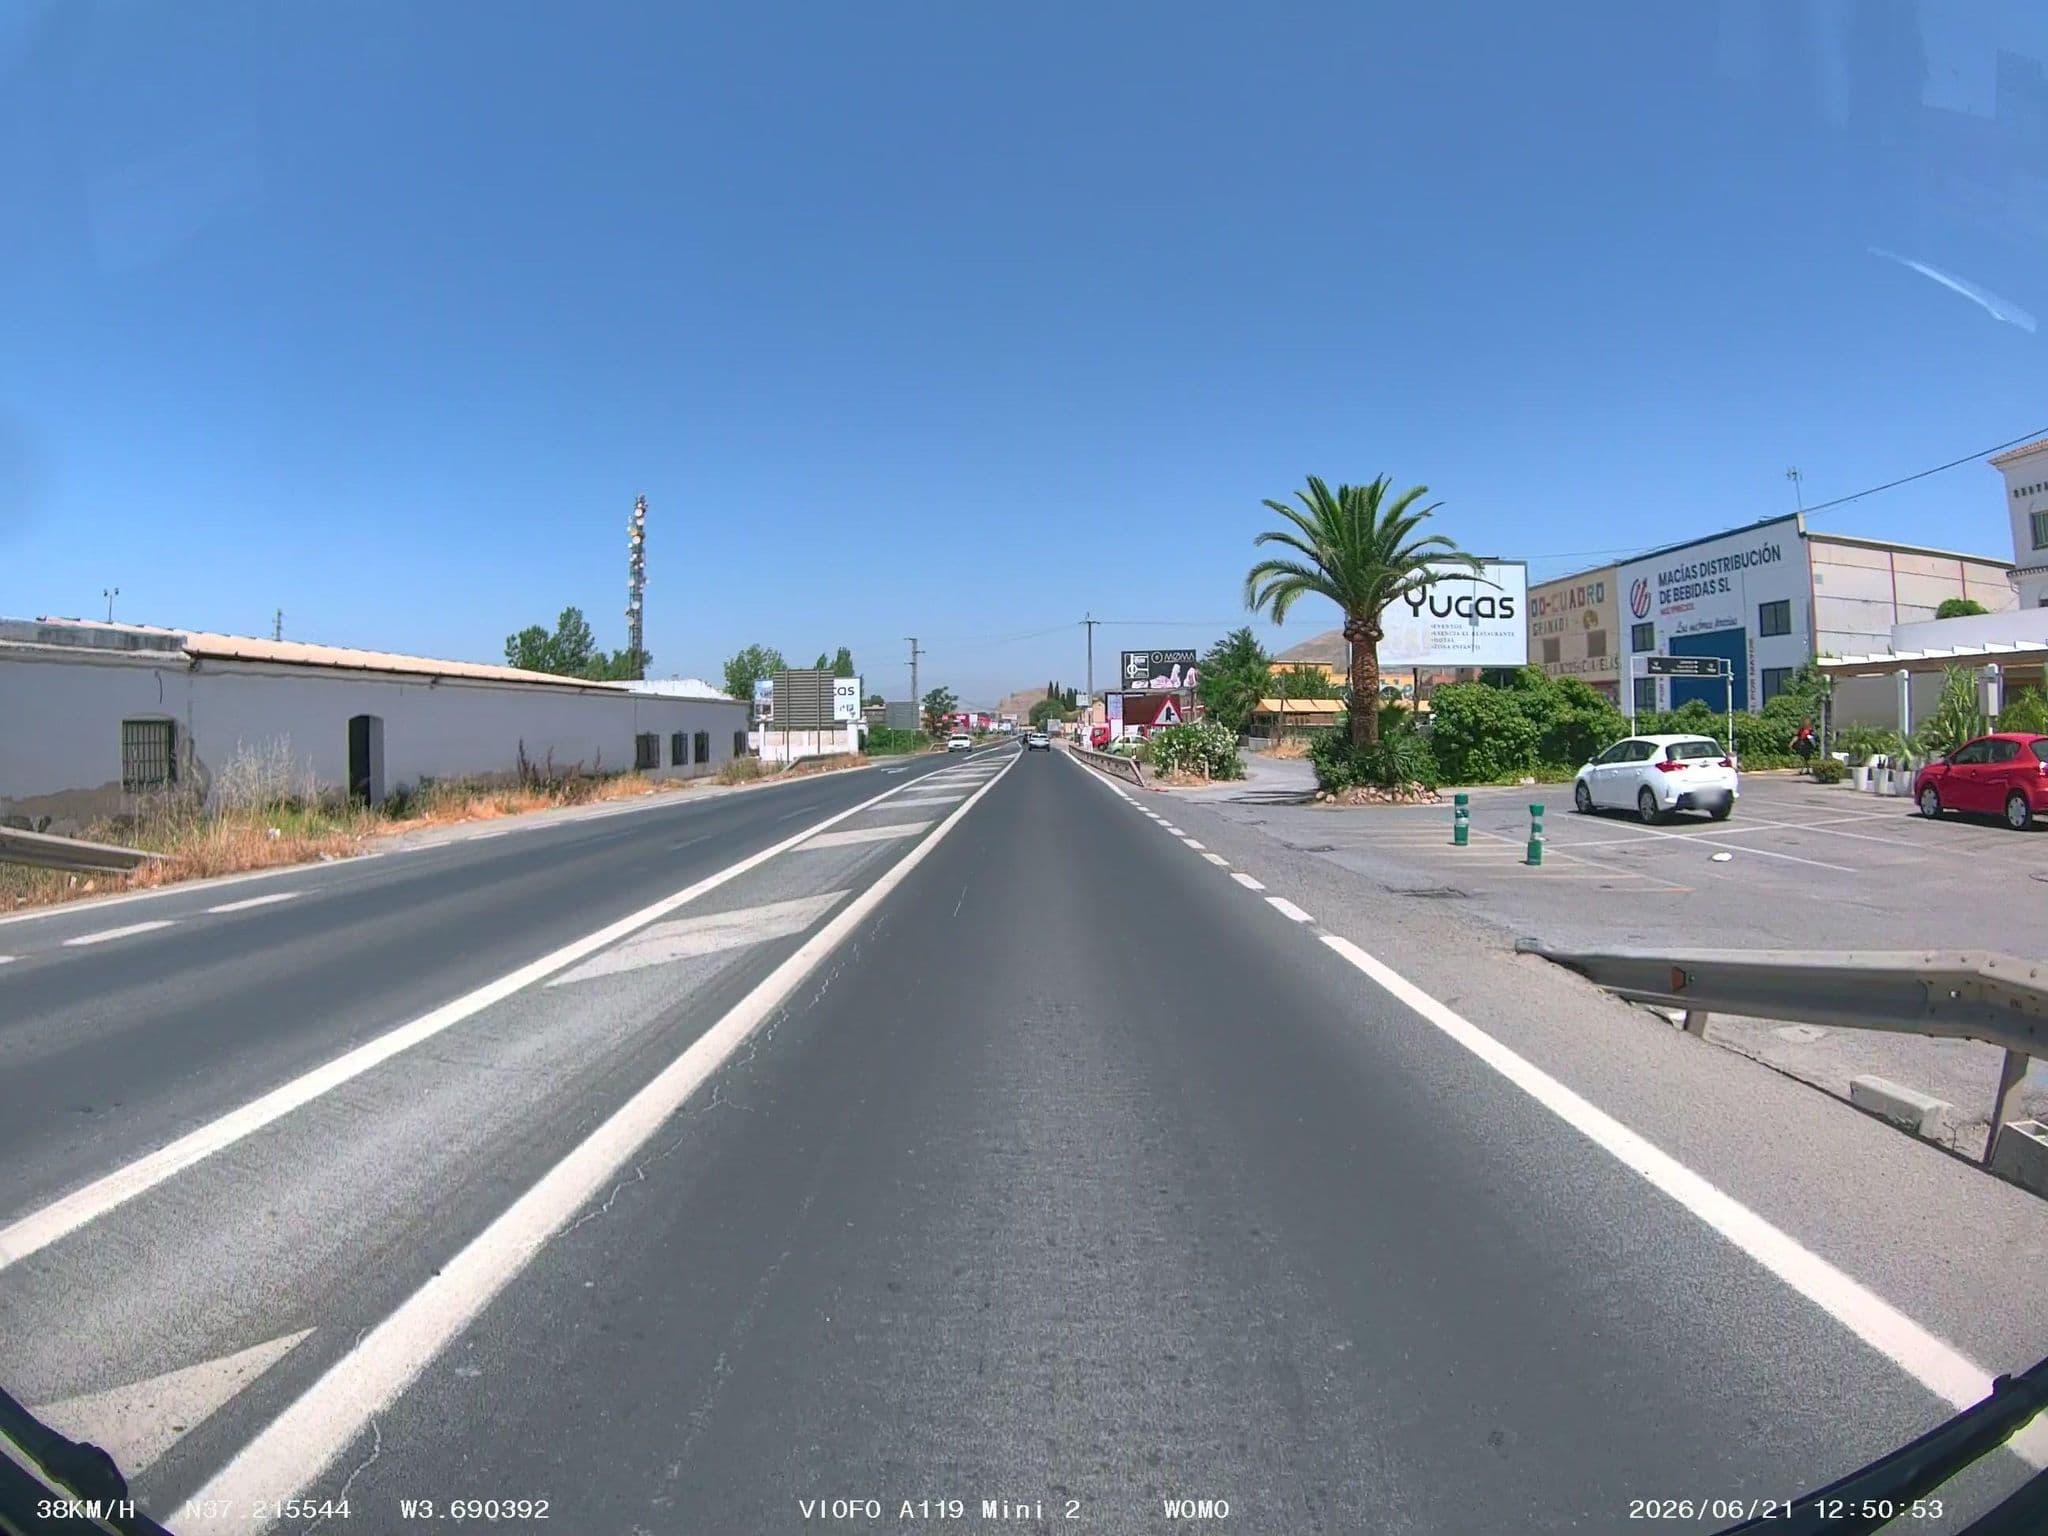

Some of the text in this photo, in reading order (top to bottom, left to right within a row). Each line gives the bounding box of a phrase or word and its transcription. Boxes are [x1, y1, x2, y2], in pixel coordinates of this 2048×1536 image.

[1658, 542, 1781, 587] MACÍAS DISTRIBUCIÓN
[1403, 584, 1515, 619] Yucas
[1660, 577, 1731, 605] DE BEBIDAS SL
